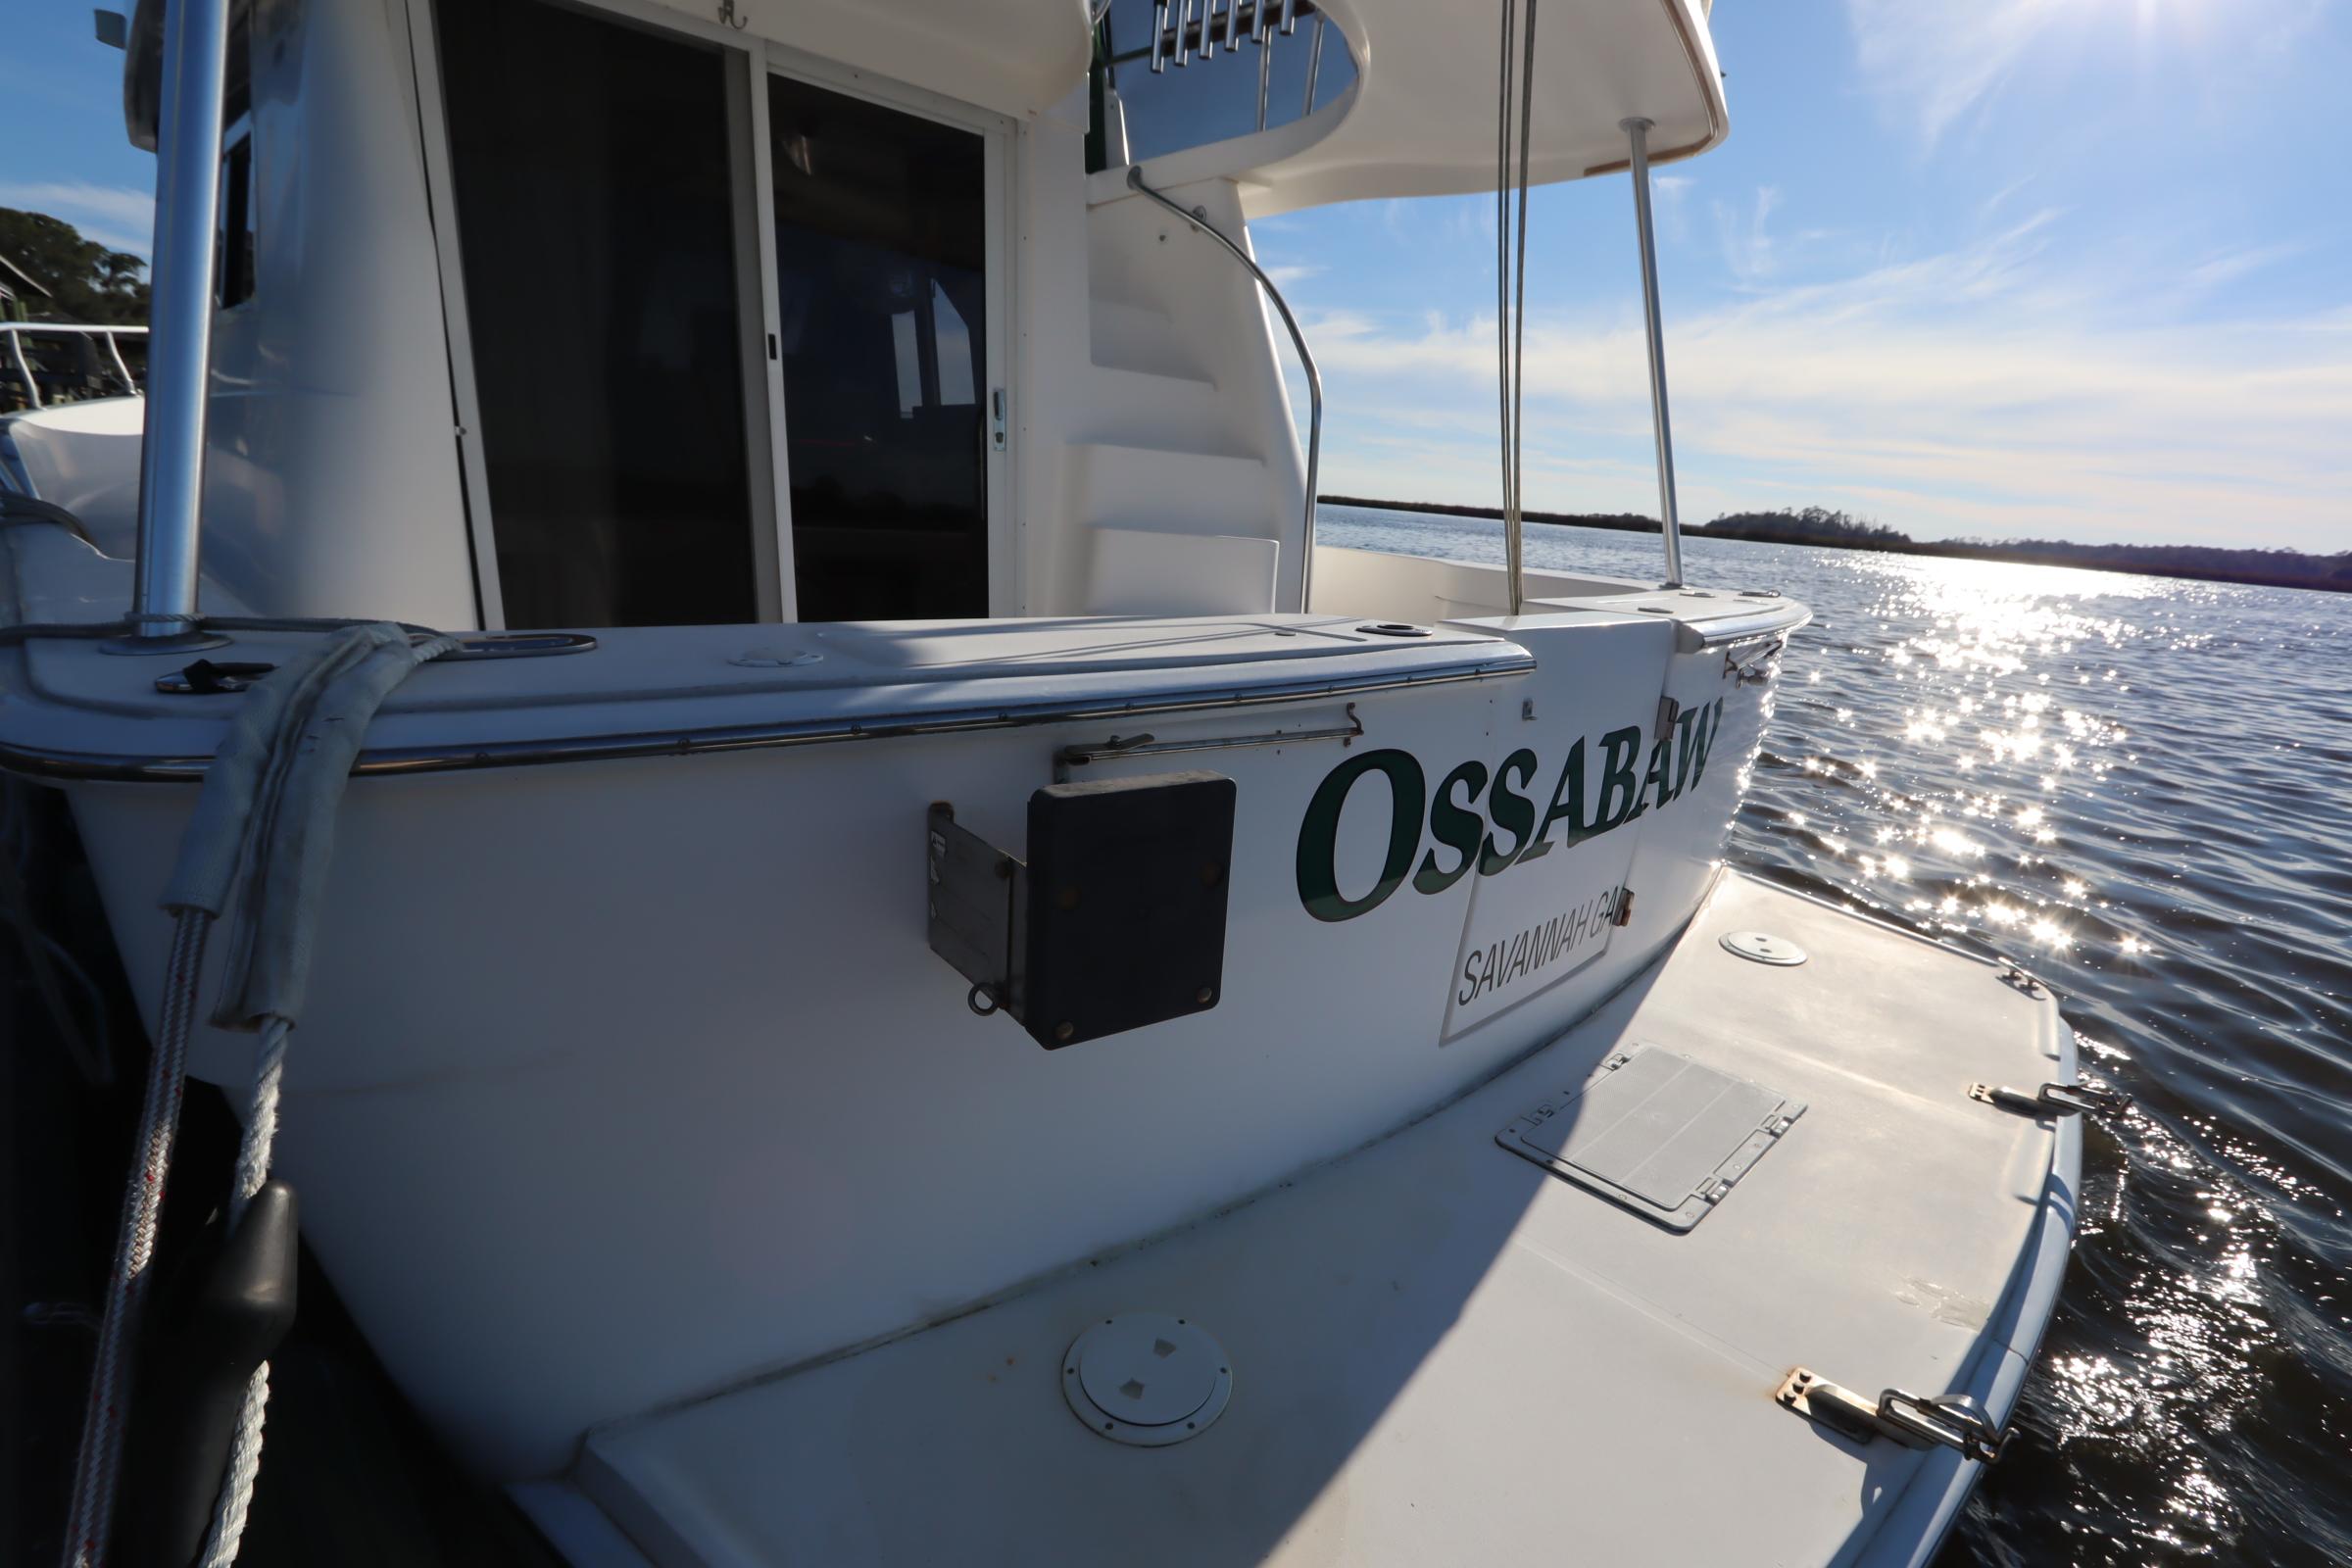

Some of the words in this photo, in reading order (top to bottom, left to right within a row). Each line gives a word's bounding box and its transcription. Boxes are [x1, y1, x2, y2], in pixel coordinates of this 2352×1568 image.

[1296, 696, 1724, 922] OSSABAW
[1458, 899, 1593, 1006] SAVANNAH
[1590, 885, 1619, 938] GA
